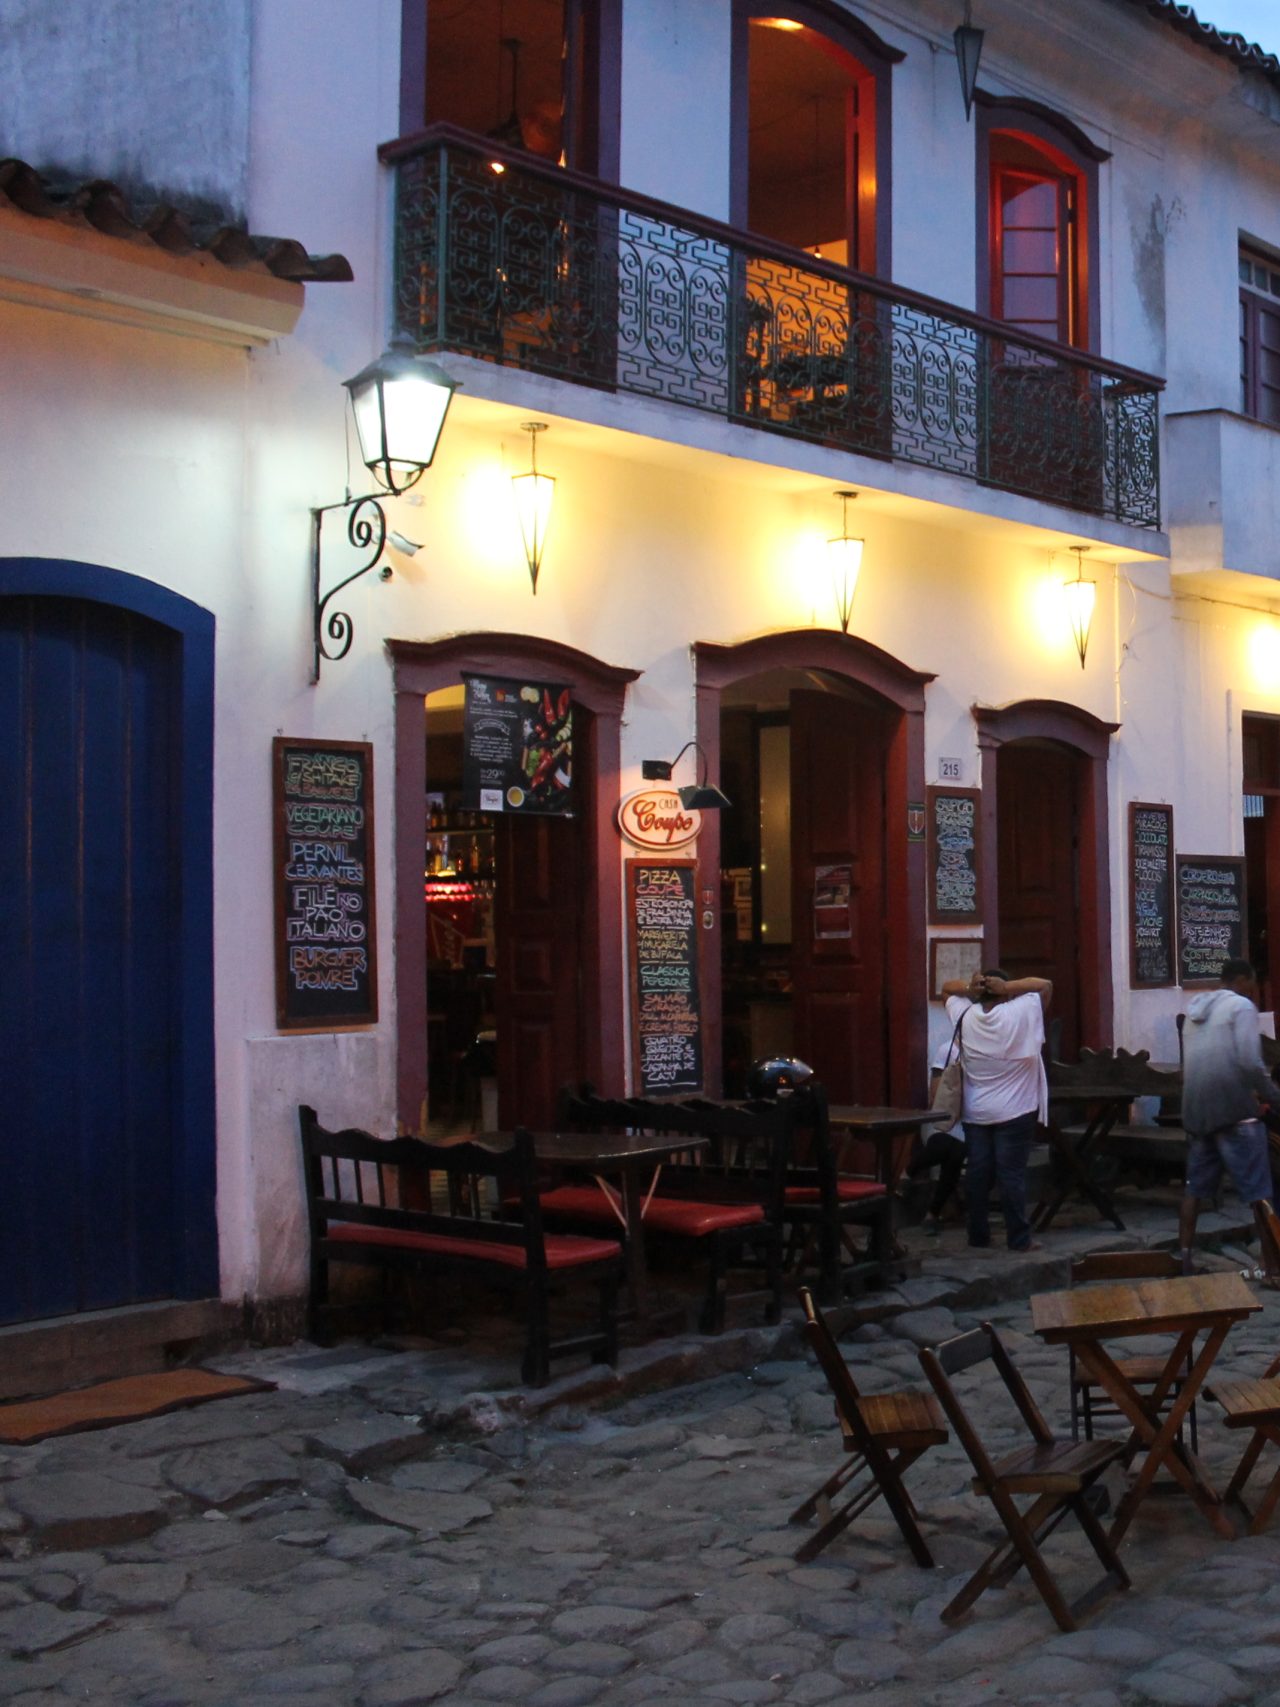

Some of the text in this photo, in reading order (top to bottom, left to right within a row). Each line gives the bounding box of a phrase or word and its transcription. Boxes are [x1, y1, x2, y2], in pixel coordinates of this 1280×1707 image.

[288, 756, 359, 774] FRANGO
[943, 763, 959, 776] 215
[658, 799, 679, 809] CASA
[287, 804, 363, 825] VEGETARIANO
[292, 842, 355, 863] PERNIL
[286, 863, 364, 881] CERVANTES
[640, 869, 681, 885] PIZZA
[338, 893, 361, 910] NO
[287, 920, 365, 938] ITALIANO
[294, 949, 363, 970] BURGUER
[644, 1034, 687, 1046] QUATRO
[647, 1071, 677, 1081] CAJU
